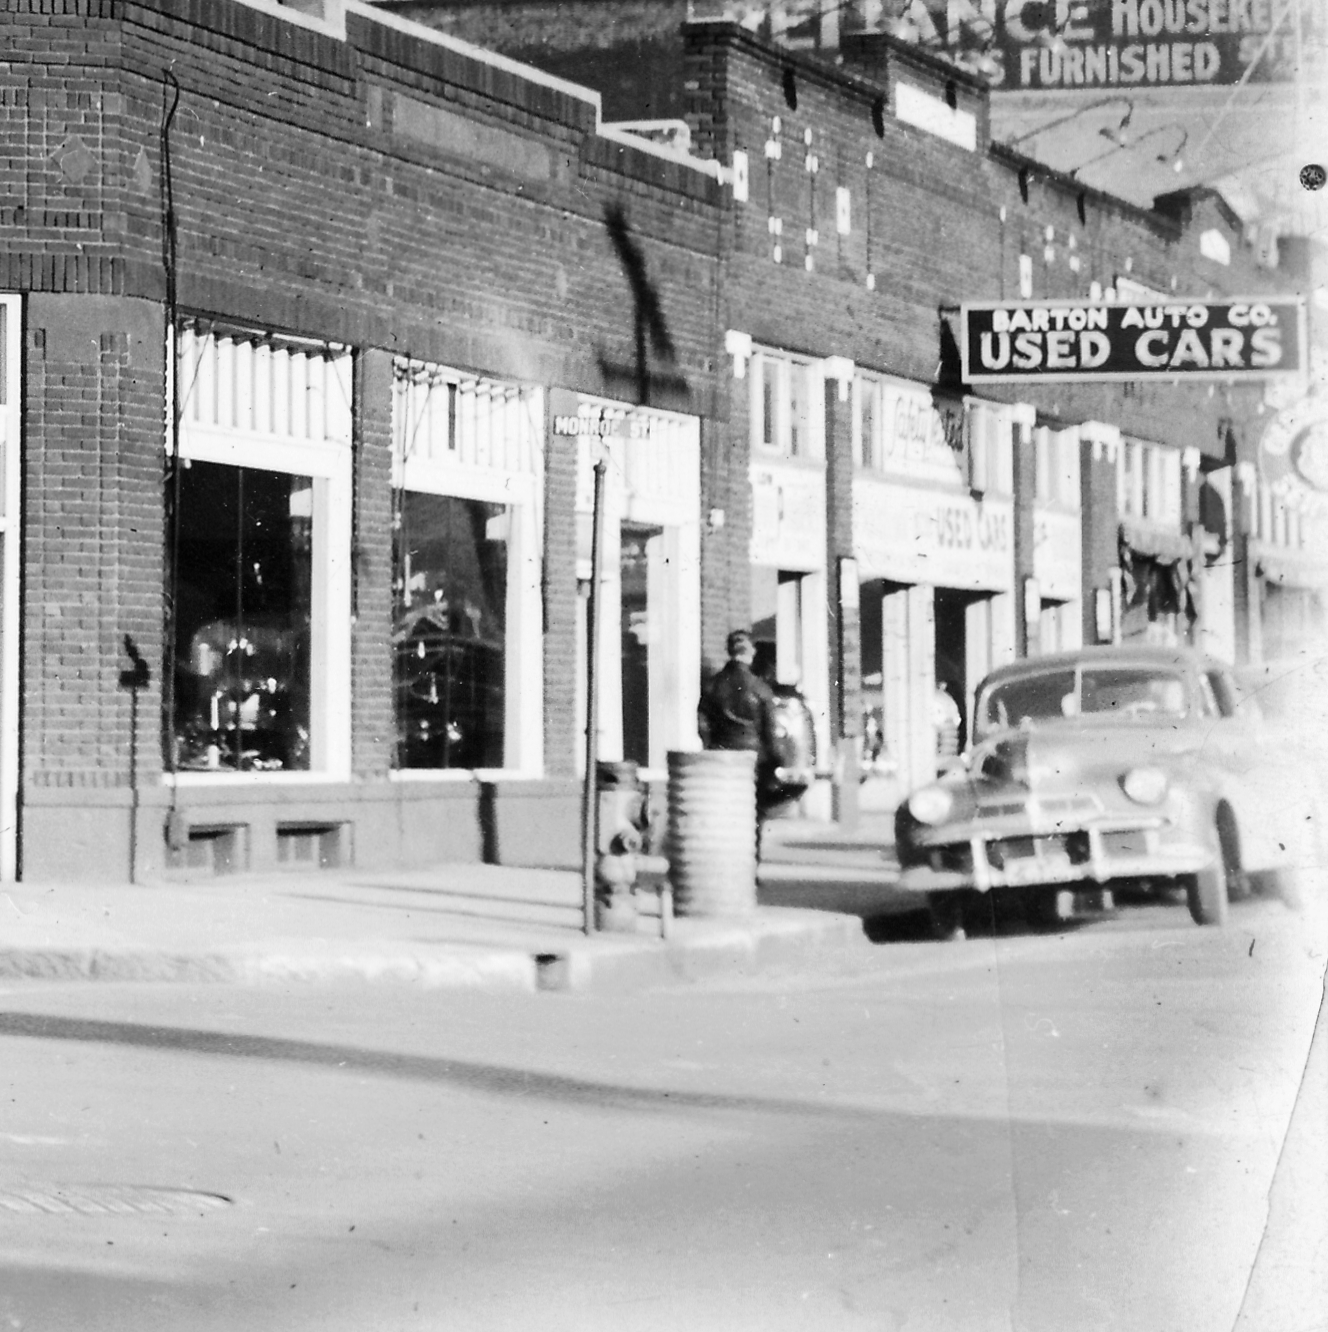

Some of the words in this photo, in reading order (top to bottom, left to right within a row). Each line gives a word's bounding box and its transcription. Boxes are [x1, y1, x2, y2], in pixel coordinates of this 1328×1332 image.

[1020, 42, 1221, 85] FURNISHED
[993, 305, 1108, 332] BARTON
[1121, 305, 1208, 328] AUTO
[1228, 304, 1278, 327] CO.
[980, 330, 1111, 368] USED
[1135, 328, 1282, 368] CARS
[555, 415, 620, 436] MONROE
